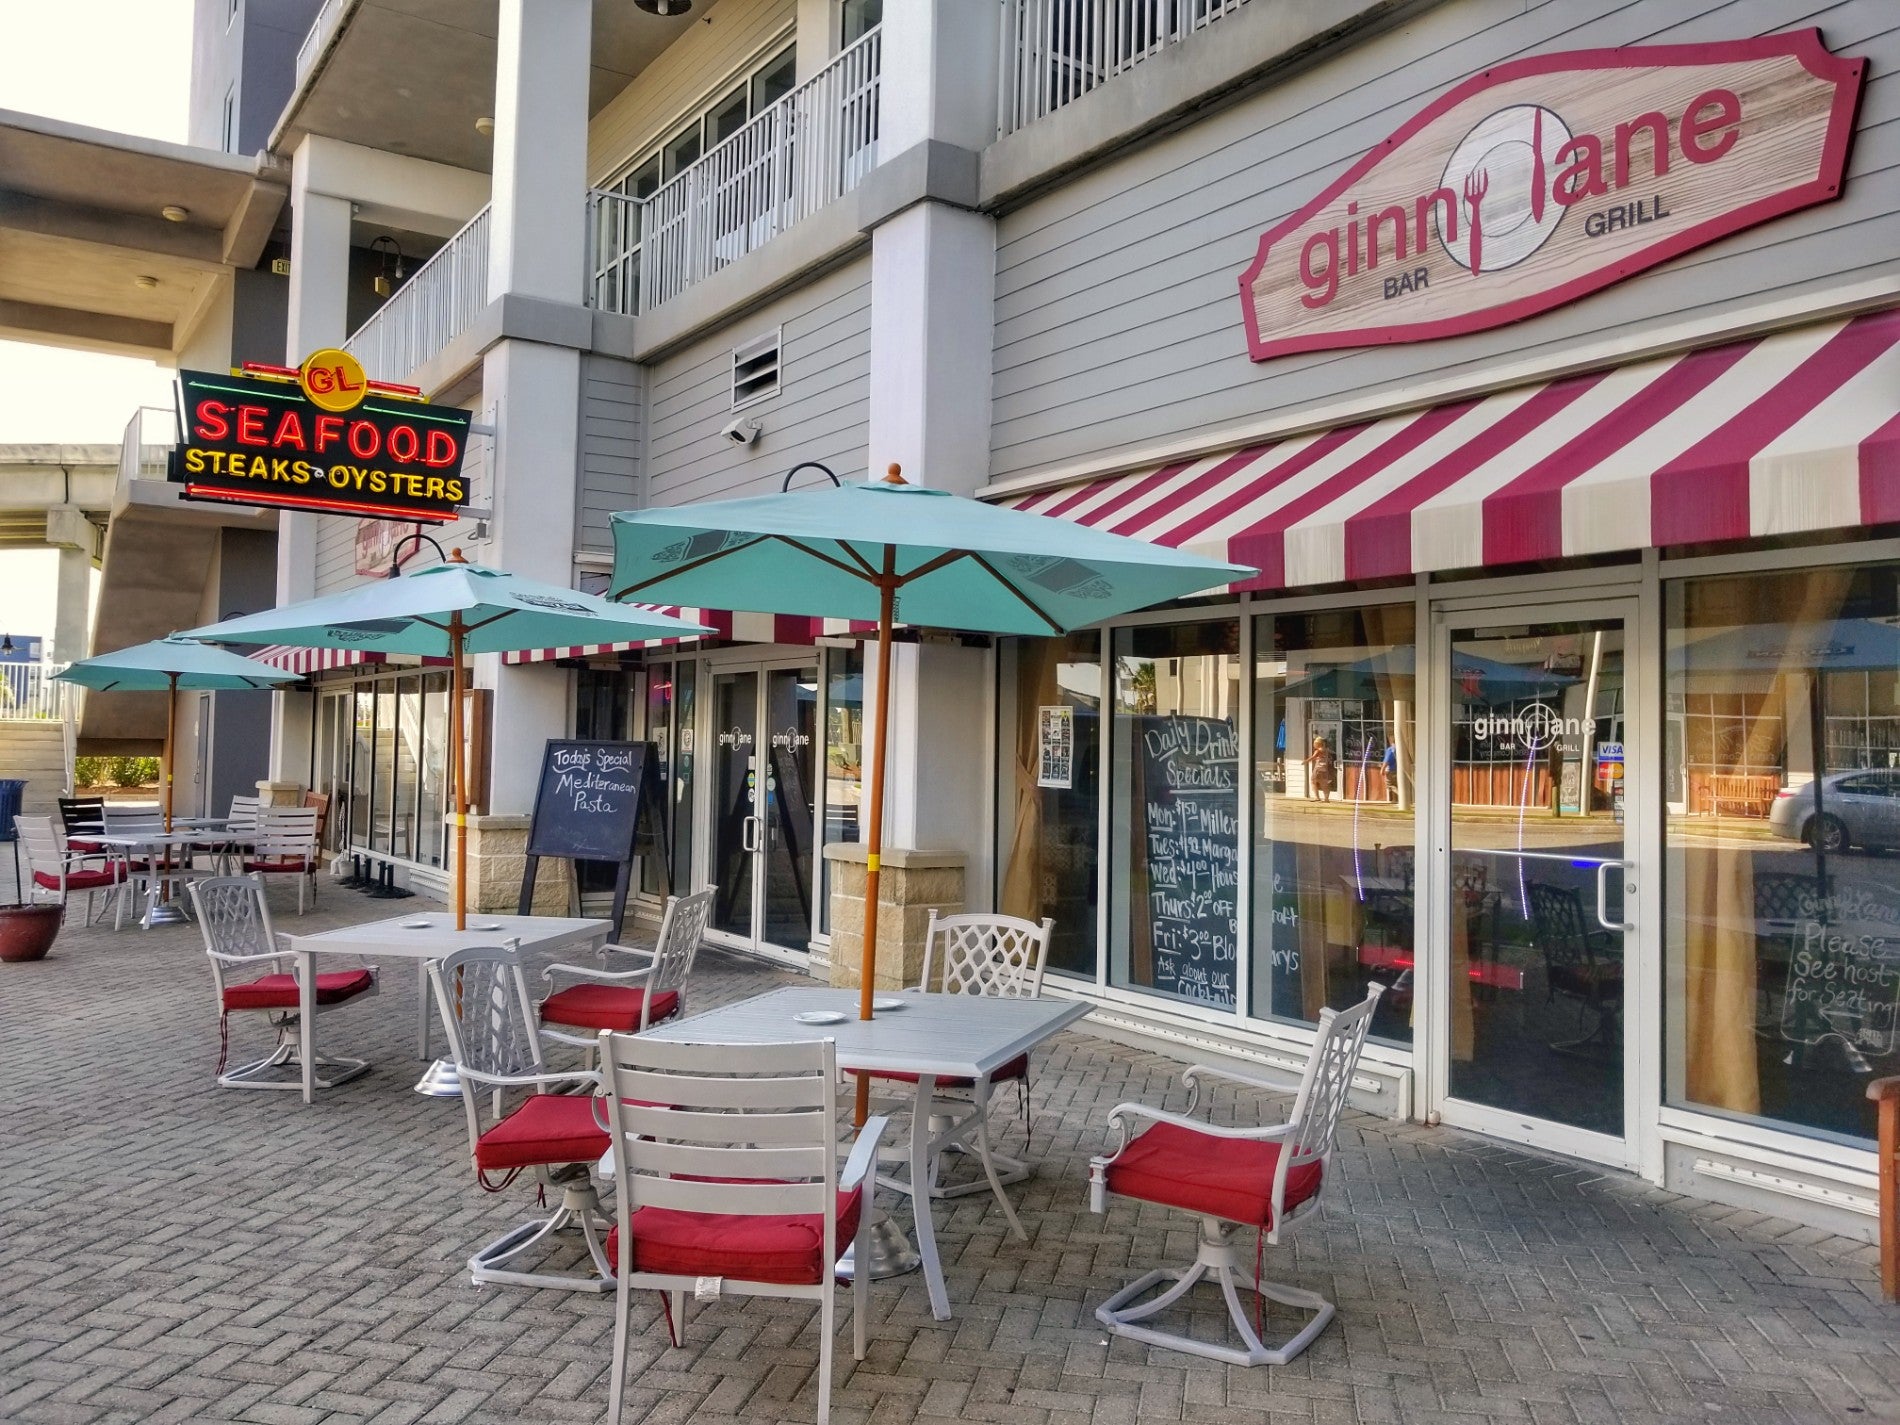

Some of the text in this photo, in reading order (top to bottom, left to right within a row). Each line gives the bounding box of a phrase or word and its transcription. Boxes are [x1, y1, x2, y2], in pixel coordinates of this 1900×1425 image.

[1584, 194, 1670, 239] GRILL
[276, 260, 290, 273] EXI
[1383, 266, 1430, 301] BAR
[306, 365, 361, 396] GL
[194, 399, 458, 467] SEAFOOD
[185, 449, 464, 501] STEAKS OYSTERS
[1144, 715, 1239, 760] Daily Drink
[1556, 744, 1580, 752] GRILL
[1602, 745, 1624, 754] VISA
[596, 748, 632, 770] Special
[1166, 760, 1231, 789] Specials
[555, 772, 637, 797] Mediteranean
[574, 791, 618, 813] Pasta
[1147, 802, 1176, 828] Mon:
[1200, 808, 1239, 837] Miller
[1148, 833, 1179, 857] Tues:
[1202, 838, 1239, 867] Marga
[1150, 860, 1181, 885] Wed:
[1211, 861, 1239, 893] Hous
[1153, 921, 1182, 949] Fri:
[1212, 935, 1237, 961] Blo
[1805, 922, 1887, 958] Please
[1157, 955, 1230, 985] Ask about our
[1794, 951, 1890, 987] See host
[1788, 977, 1817, 1006] for
